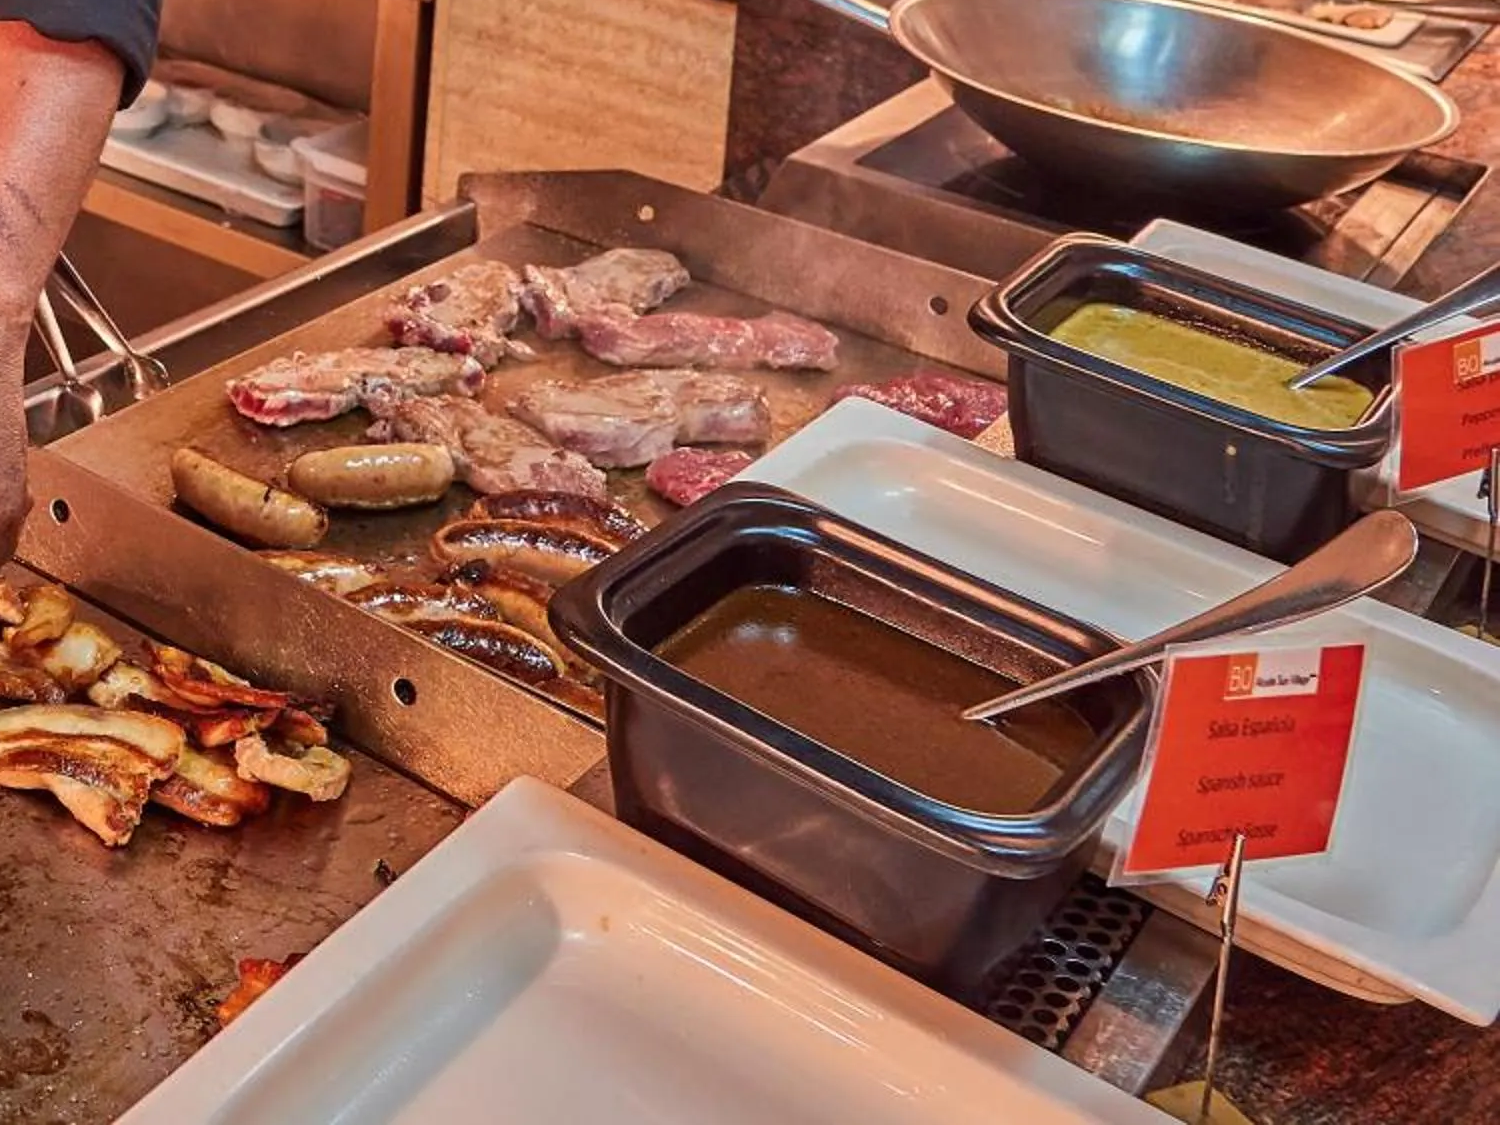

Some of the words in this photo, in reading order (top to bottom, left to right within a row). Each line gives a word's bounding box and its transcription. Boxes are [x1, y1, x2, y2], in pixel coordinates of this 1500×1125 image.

[1208, 719, 1239, 740] Salsa
[1196, 771, 1246, 794] Spanish
[1247, 772, 1285, 789] sauce
